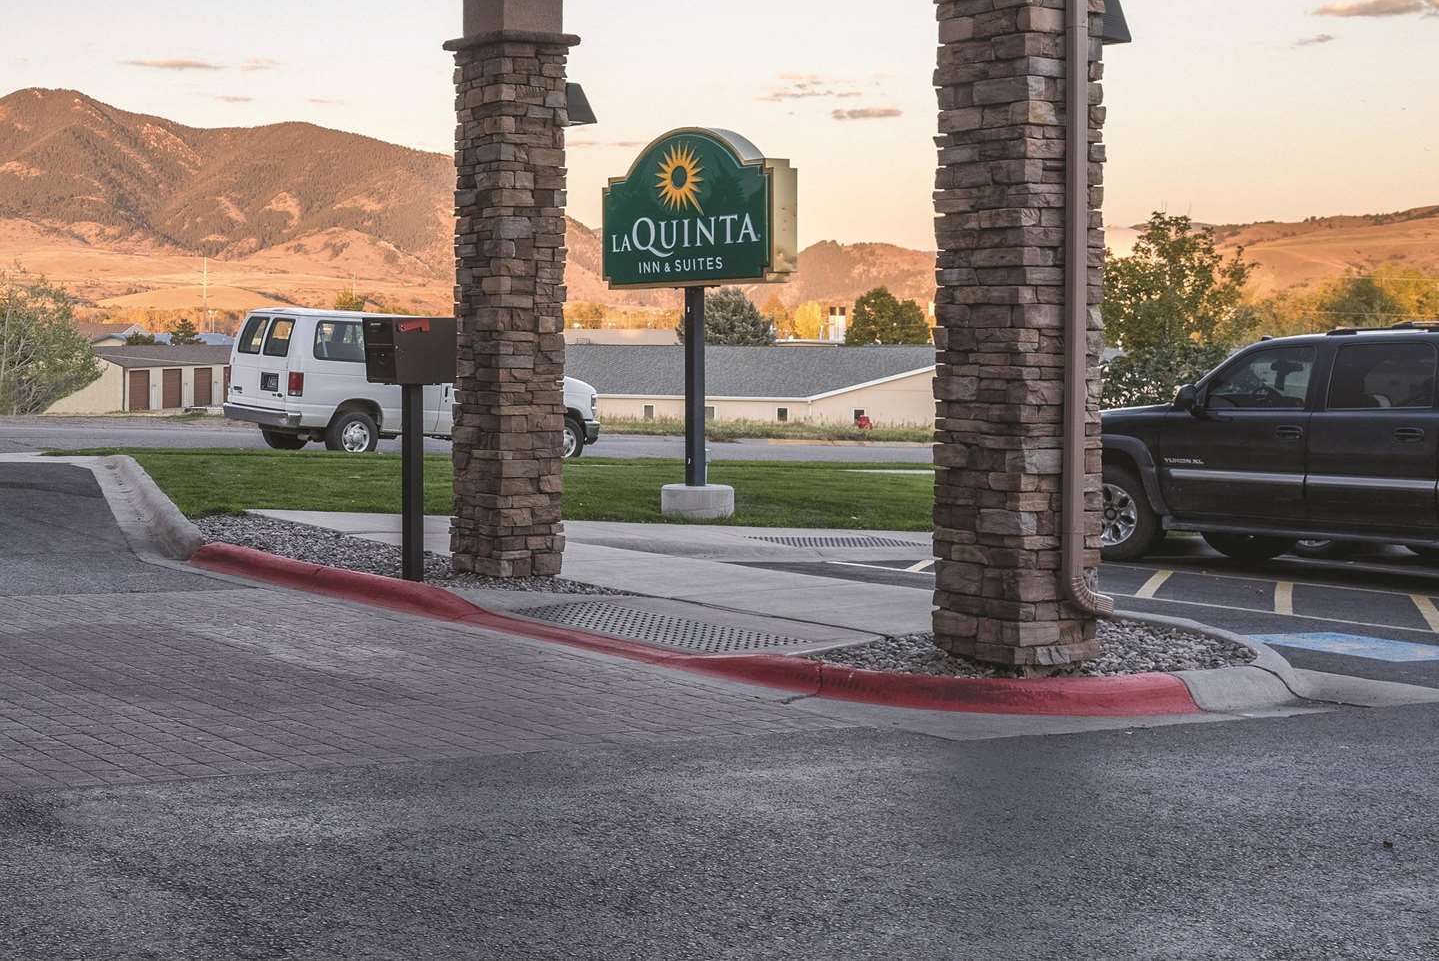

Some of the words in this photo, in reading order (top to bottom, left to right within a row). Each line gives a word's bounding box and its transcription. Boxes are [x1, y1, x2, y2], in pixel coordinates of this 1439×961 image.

[611, 234, 632, 253] LA
[632, 212, 760, 258] QUINTA
[638, 261, 661, 274] INN
[664, 262, 672, 273] &
[674, 256, 724, 272] SUITES
